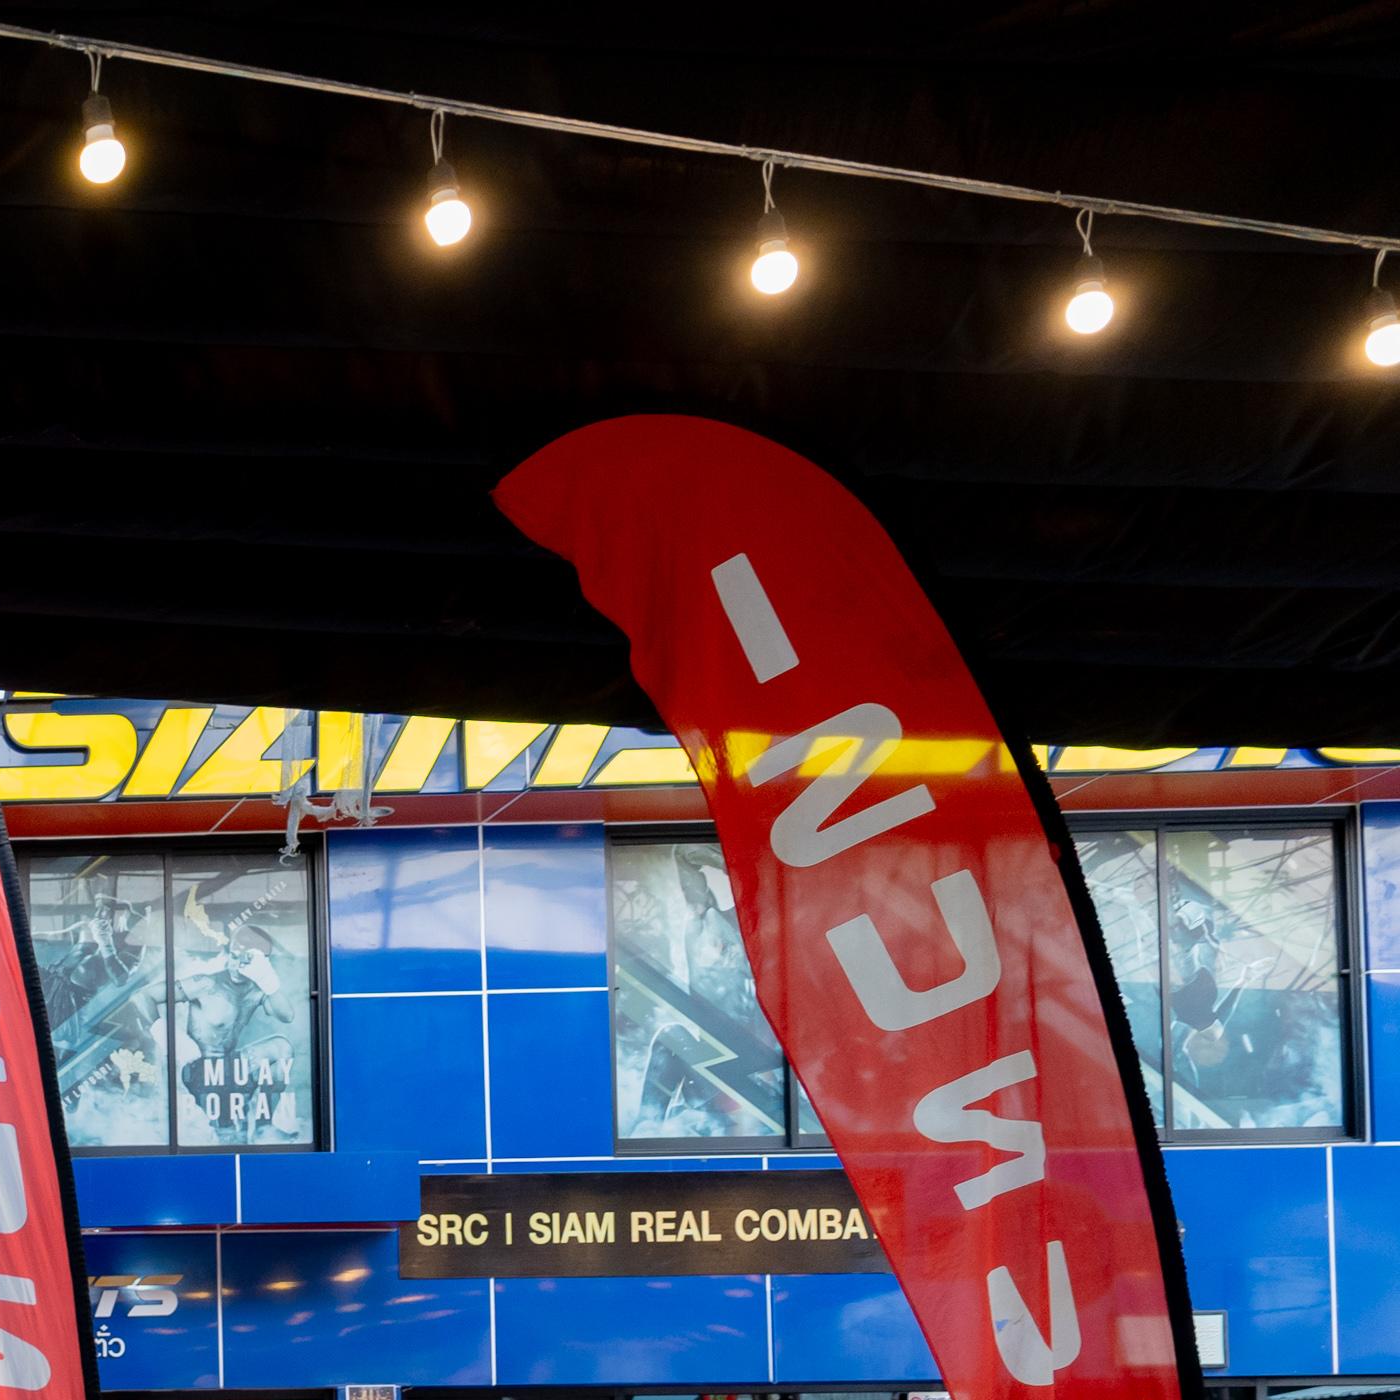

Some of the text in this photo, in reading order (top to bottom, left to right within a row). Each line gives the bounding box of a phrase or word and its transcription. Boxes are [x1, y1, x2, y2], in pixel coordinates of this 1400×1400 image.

[204, 1059, 294, 1086] MUAY
[417, 1213, 488, 1246] SRC
[529, 1212, 614, 1244] SIAM
[630, 1210, 721, 1243] REAL
[735, 1208, 877, 1241] COMBA
